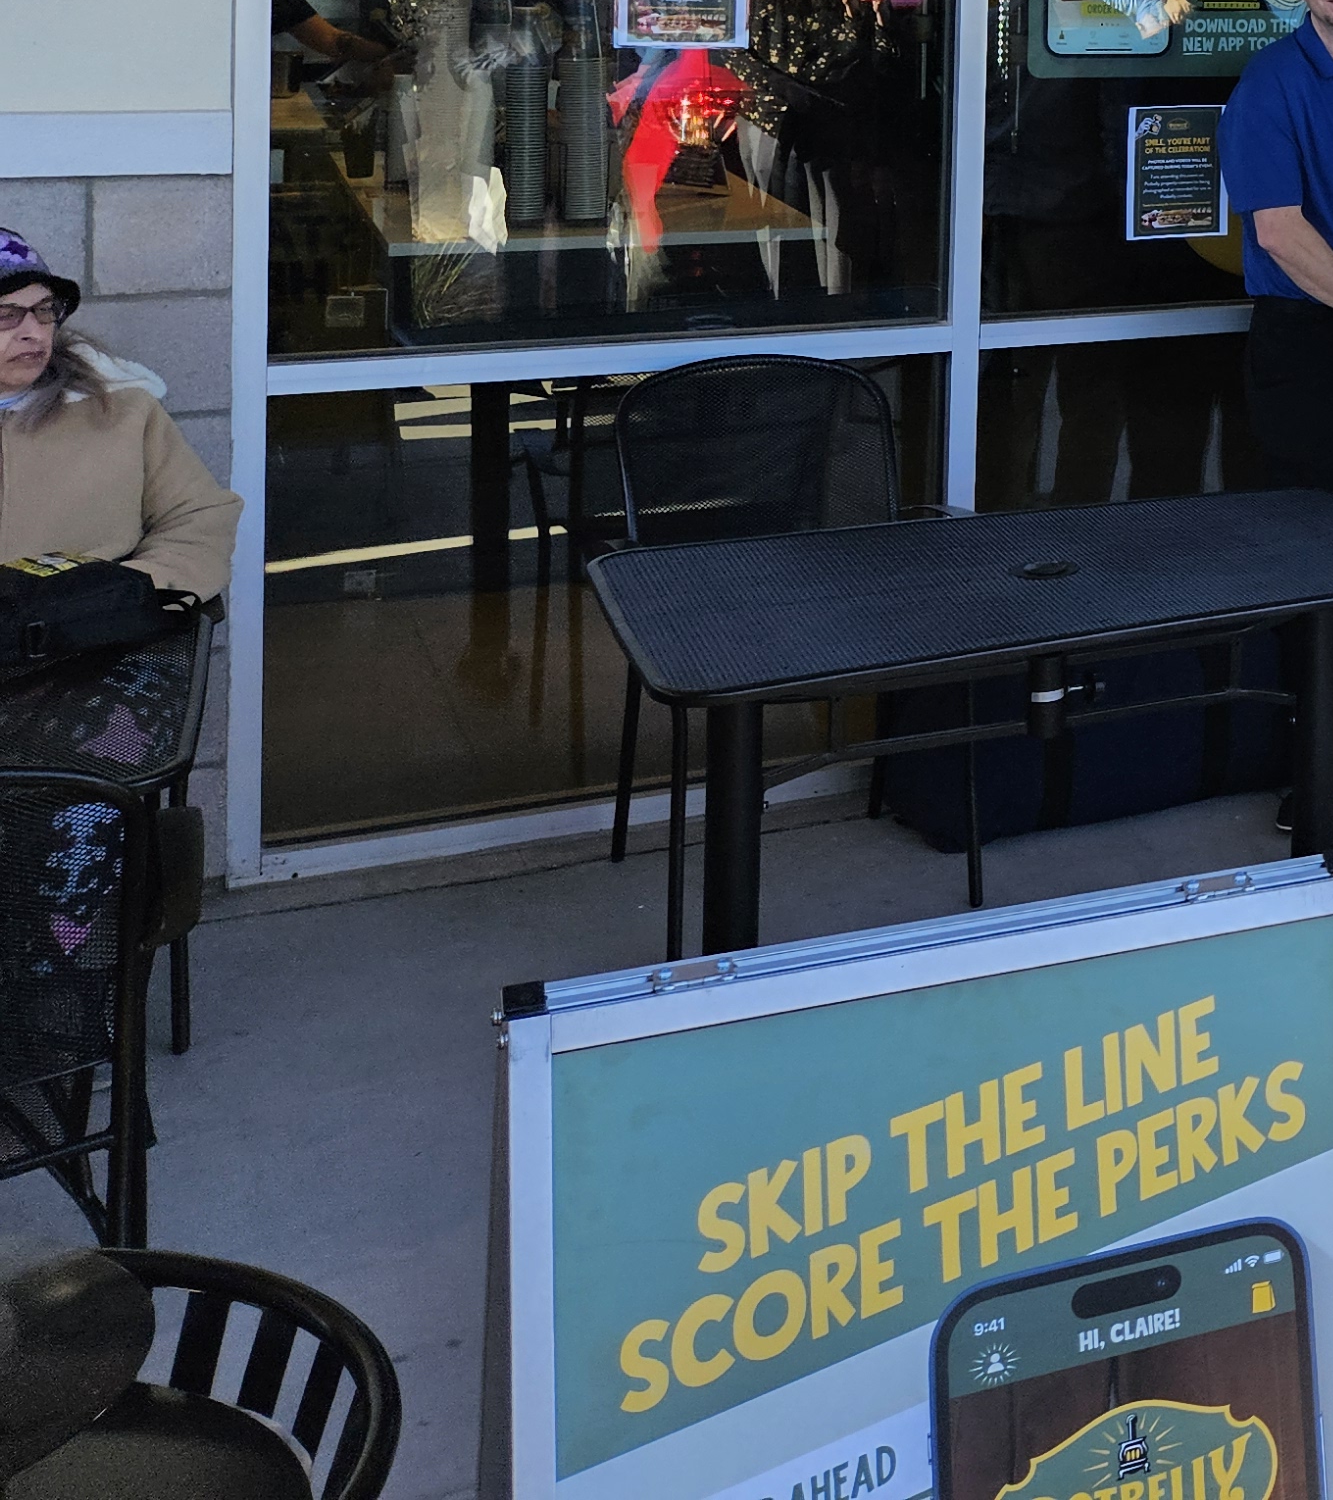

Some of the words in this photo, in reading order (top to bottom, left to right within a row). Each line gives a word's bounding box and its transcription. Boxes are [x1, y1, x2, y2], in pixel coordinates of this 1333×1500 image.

[1087, 4, 1112, 14] ORDER
[1185, 18, 1267, 33] DOWNLOAD
[1183, 37, 1214, 52] NEW
[1217, 37, 1244, 52] APP
[1248, 37, 1282, 52] TOD
[1193, 136, 1211, 145] PART
[697, 1133, 872, 1273] SKIP
[890, 1061, 1045, 1193] THE
[1064, 995, 1220, 1132] LINE
[619, 1217, 904, 1413] SCORE
[923, 1148, 1078, 1282] THE
[1096, 1061, 1306, 1216] PERKS
[973, 1316, 1006, 1337] 9:41
[1078, 1330, 1105, 1355] HI,
[1110, 1307, 1181, 1346] CLAIRE!
